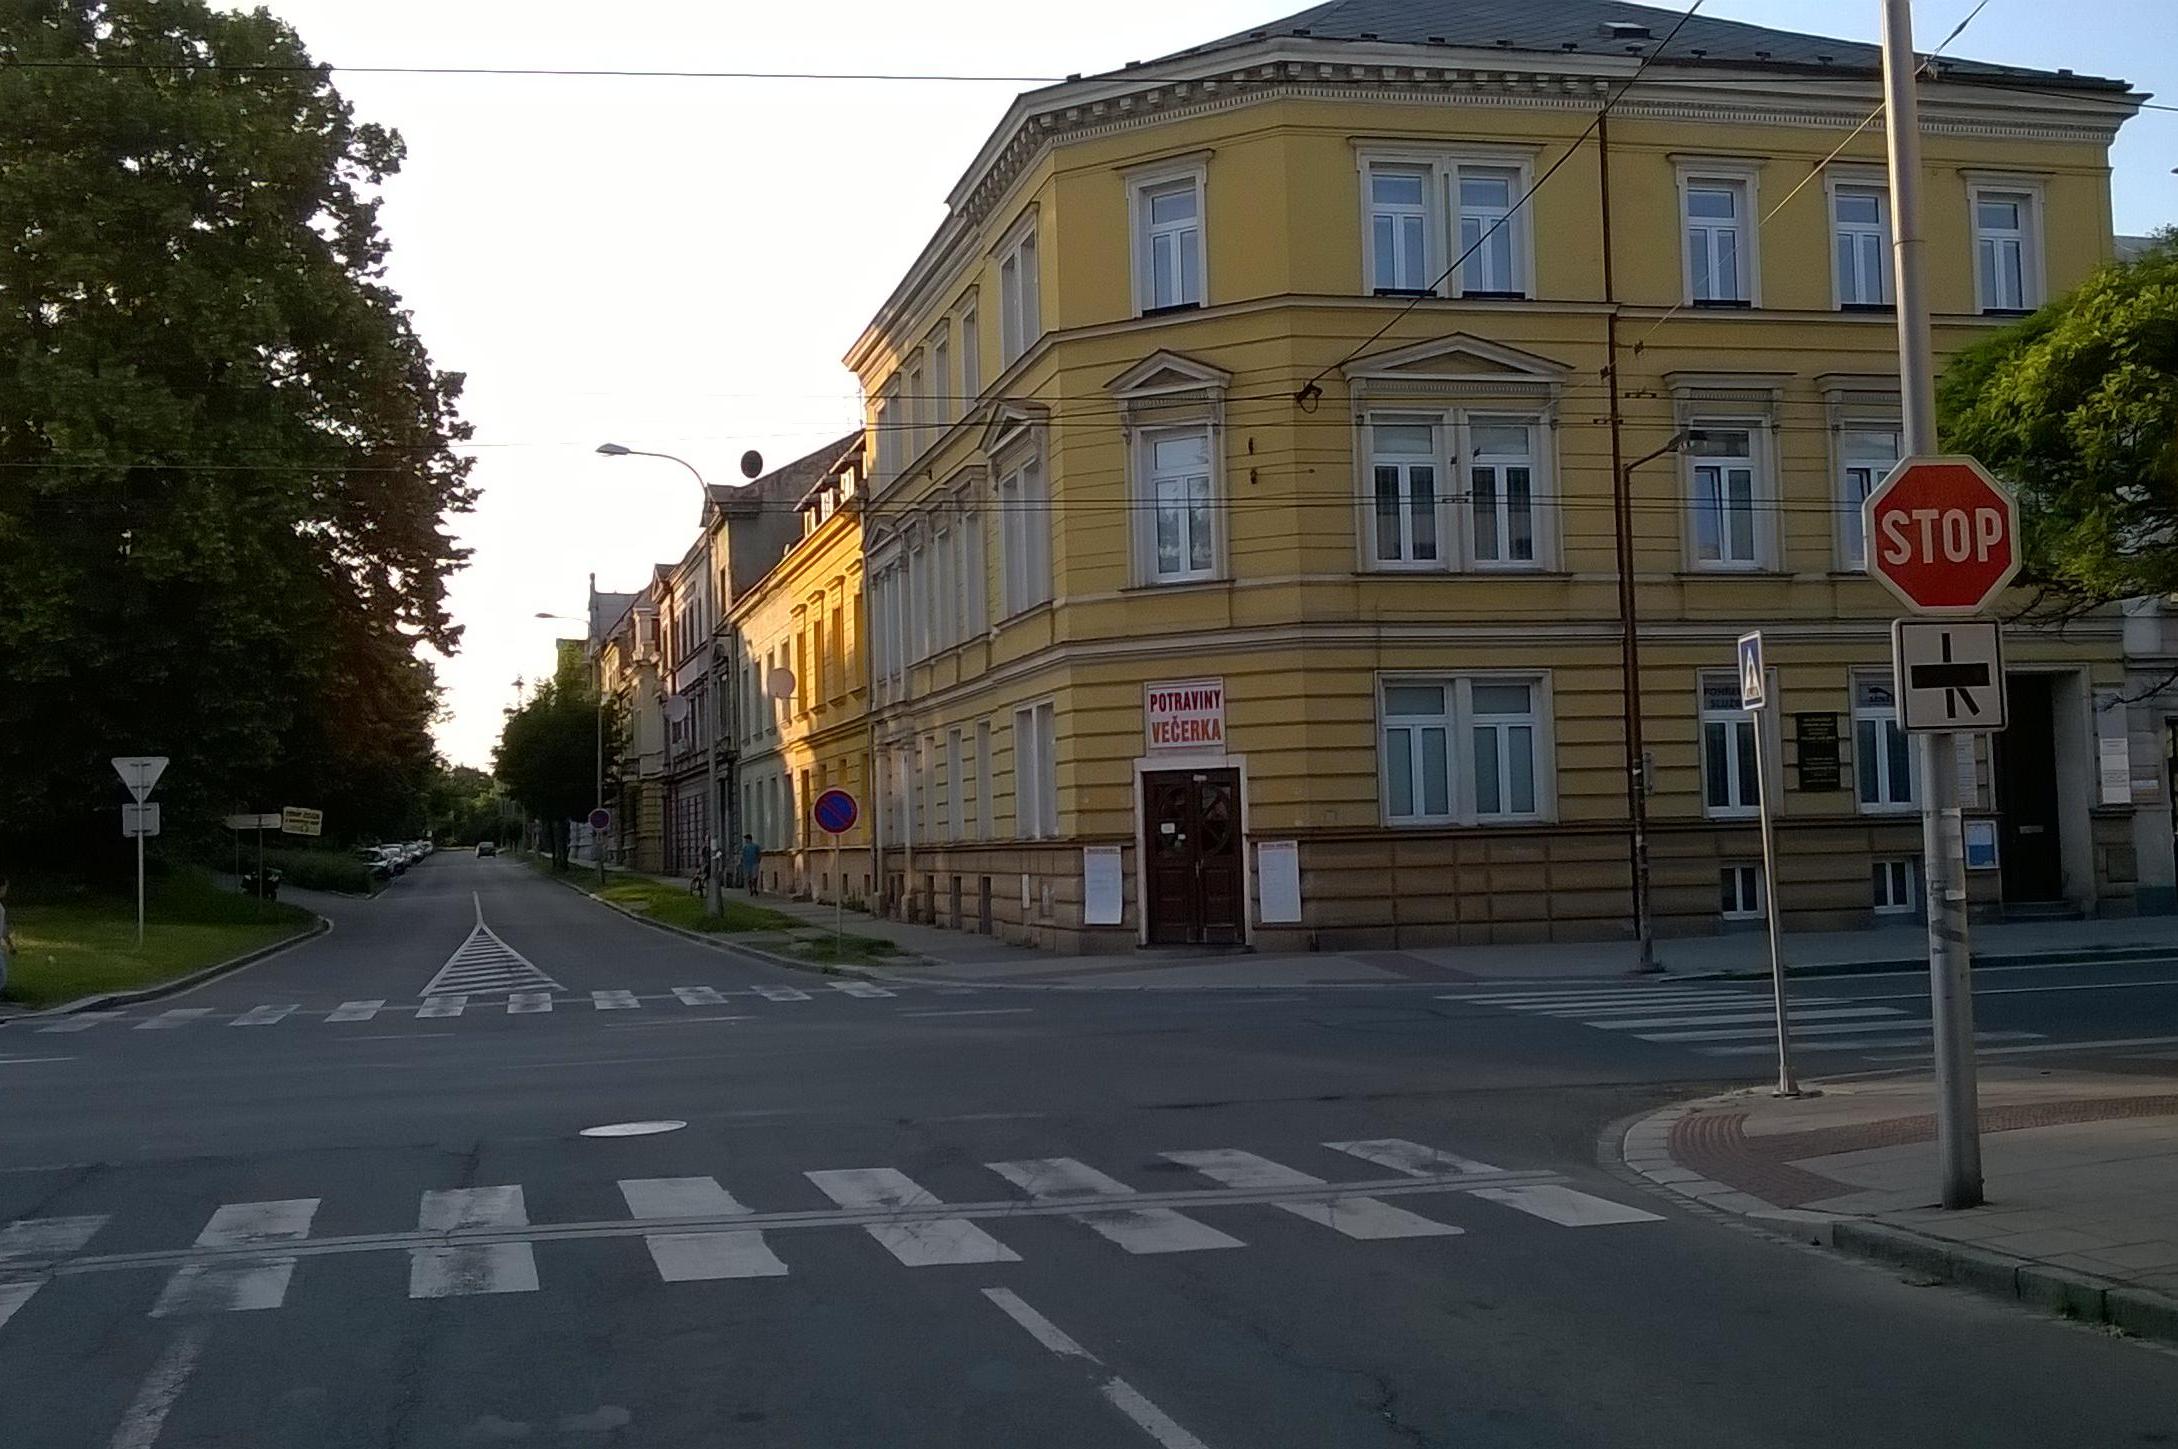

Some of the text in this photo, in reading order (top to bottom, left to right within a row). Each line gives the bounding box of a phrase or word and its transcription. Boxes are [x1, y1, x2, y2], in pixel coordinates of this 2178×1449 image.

[1882, 508, 2002, 564] STOP
[1150, 690, 1221, 712] POTRAVINY
[1152, 715, 1221, 743] VEČERKA
